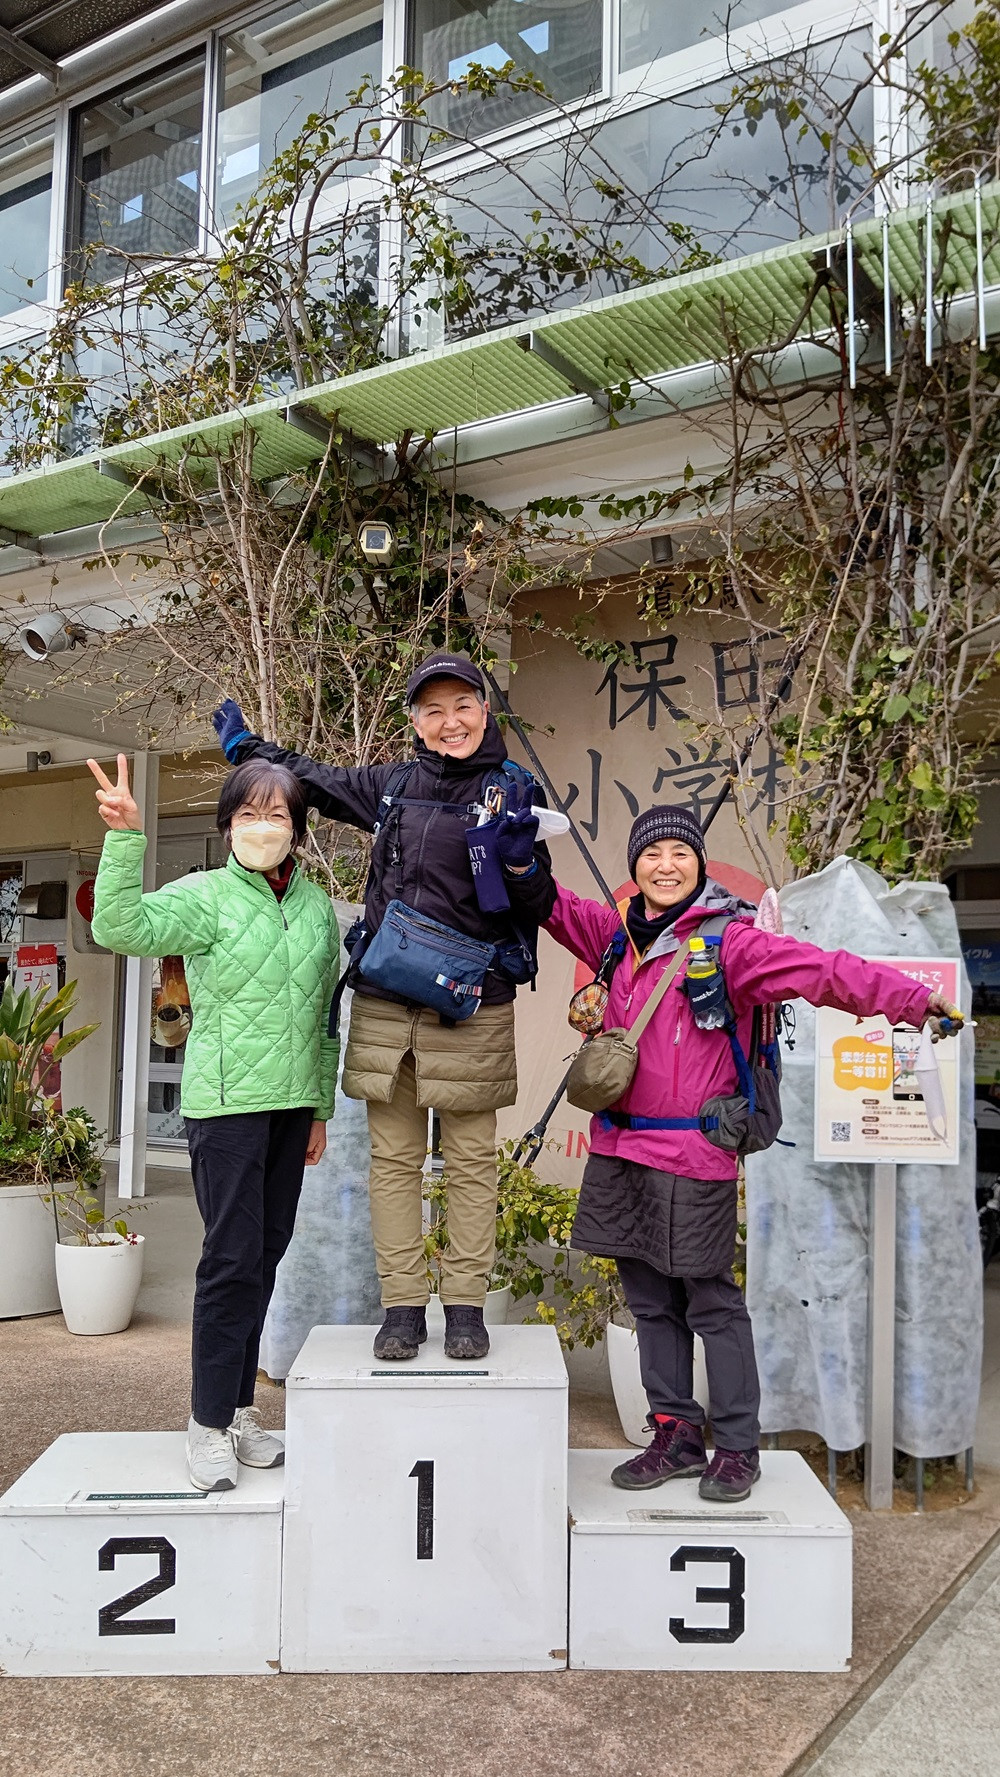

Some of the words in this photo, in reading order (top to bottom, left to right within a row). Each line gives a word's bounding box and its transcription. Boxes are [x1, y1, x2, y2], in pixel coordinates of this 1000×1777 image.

[594, 627, 794, 731] 保田
[840, 1051, 889, 1064] 表彰台で
[408, 1459, 436, 1560] 1
[98, 1536, 177, 1637] 2
[669, 1545, 746, 1644] 3
